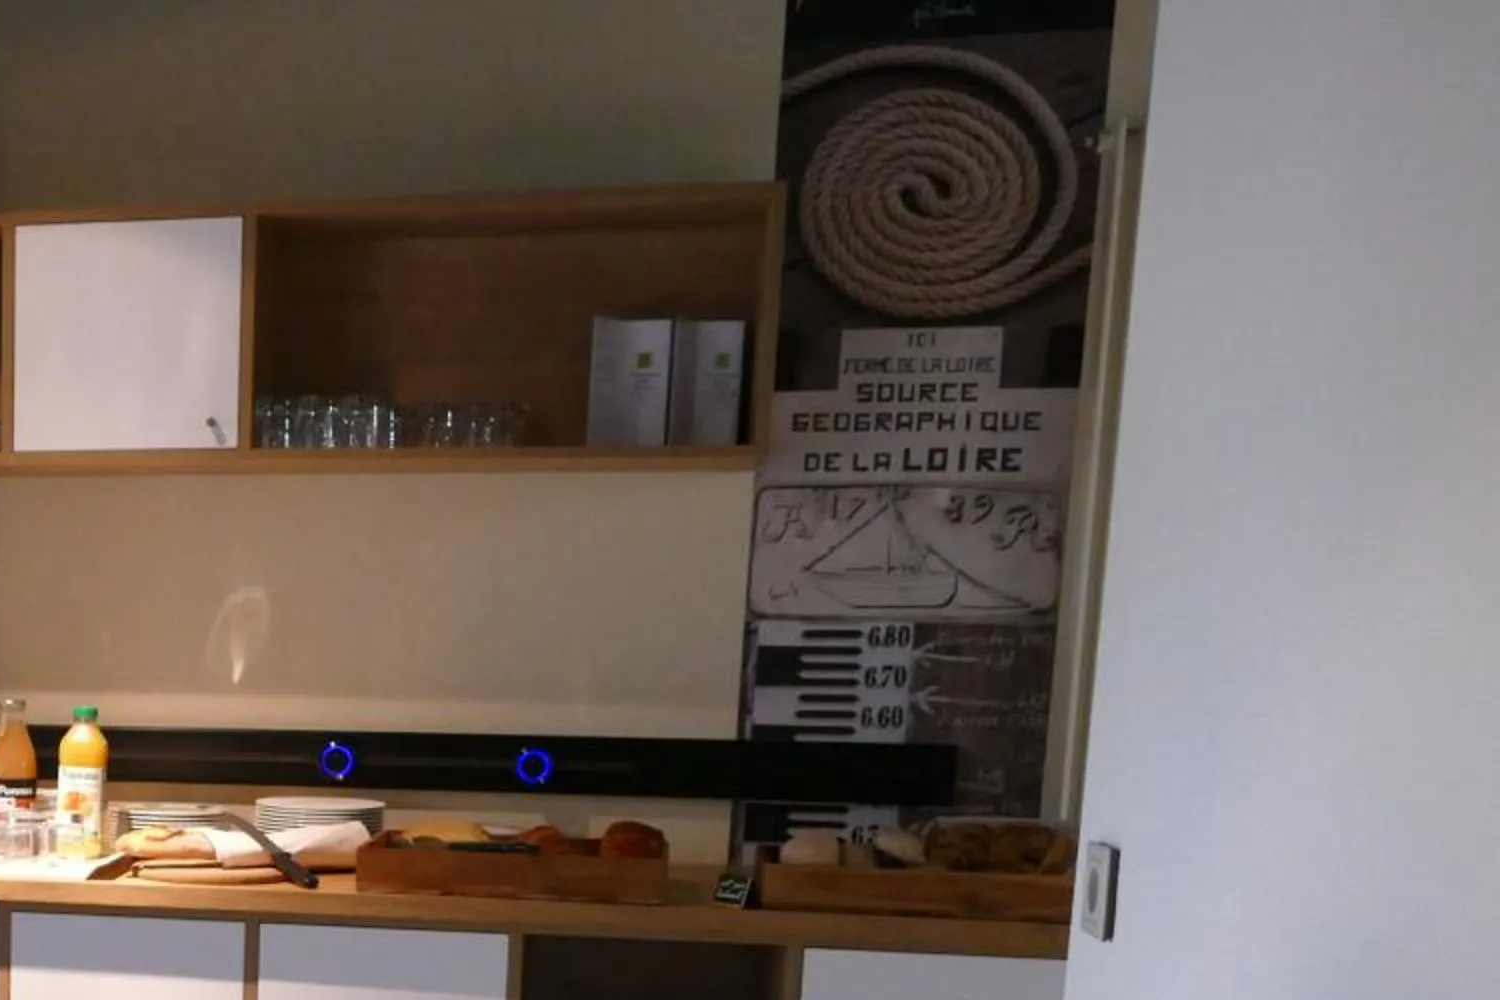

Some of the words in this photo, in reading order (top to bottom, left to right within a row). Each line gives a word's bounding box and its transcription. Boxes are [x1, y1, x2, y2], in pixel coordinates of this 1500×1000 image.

[856, 382, 980, 403] SOURCE
[791, 410, 1043, 433] GEOGRAPHIQUE
[803, 452, 843, 472] DE
[852, 452, 892, 471] LA
[902, 443, 1023, 473] LOIRE
[864, 665, 907, 688] 6.70
[861, 705, 904, 729] 6.60
